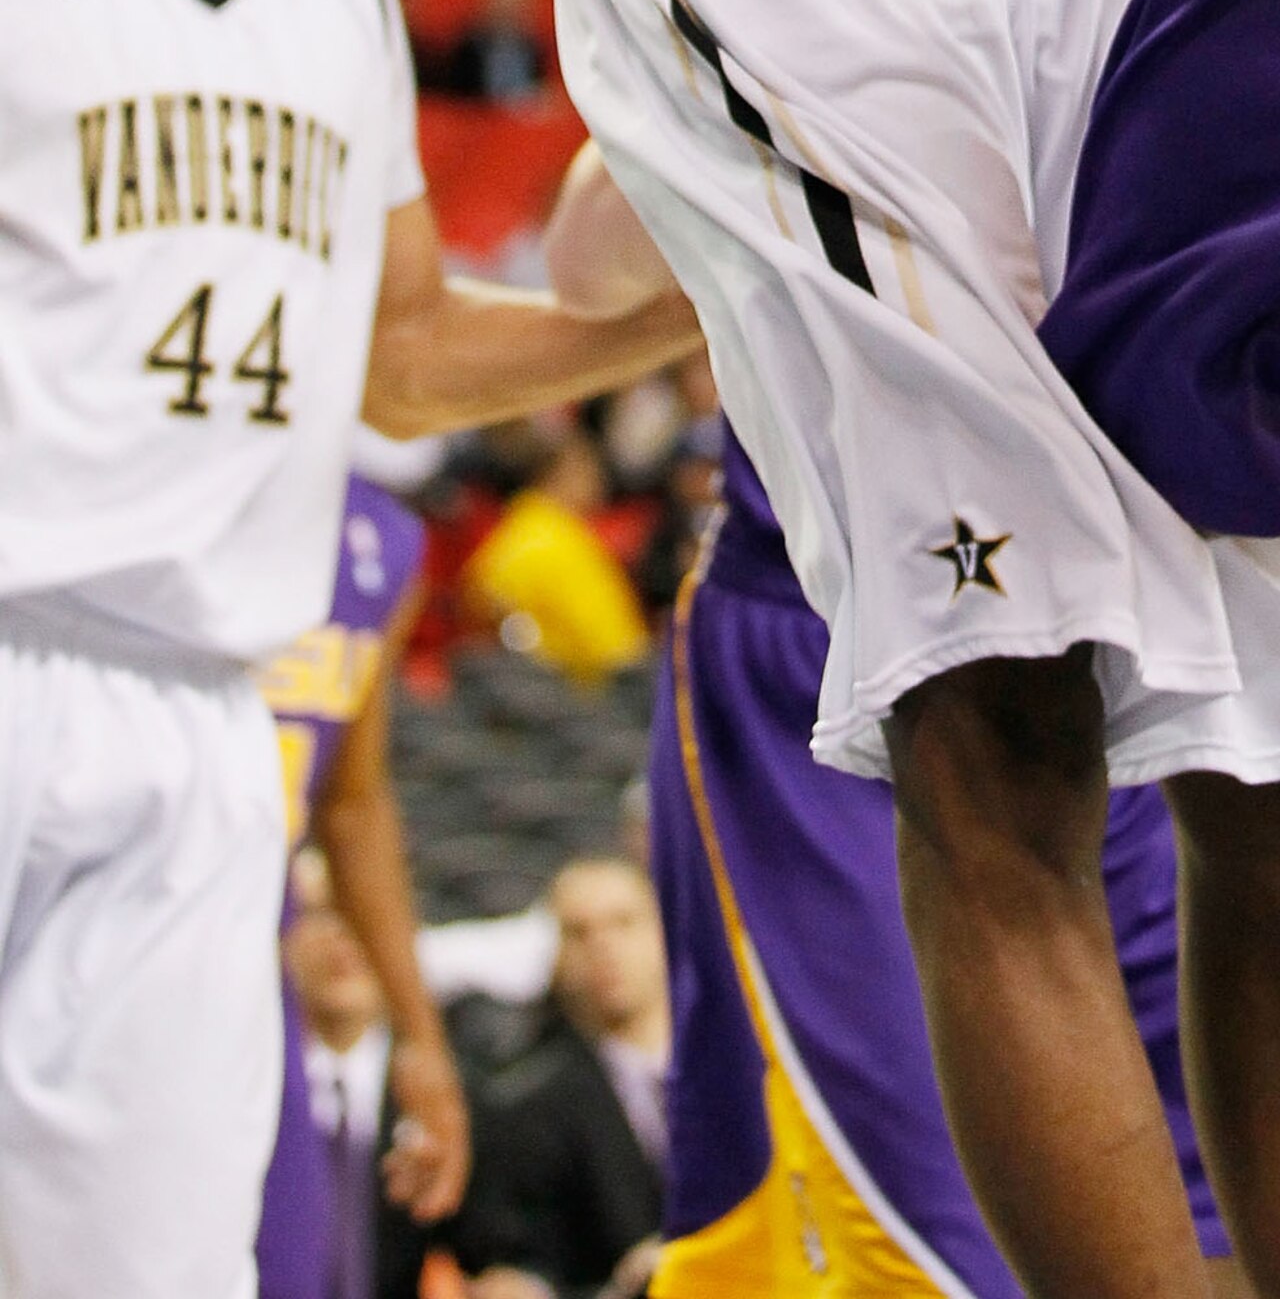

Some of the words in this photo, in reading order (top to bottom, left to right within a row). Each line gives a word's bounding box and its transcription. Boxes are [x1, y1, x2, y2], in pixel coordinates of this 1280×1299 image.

[76, 92, 348, 265] VANDERBILT
[143, 281, 290, 425] 44
[955, 542, 978, 577] V
[260, 623, 381, 723] SU
